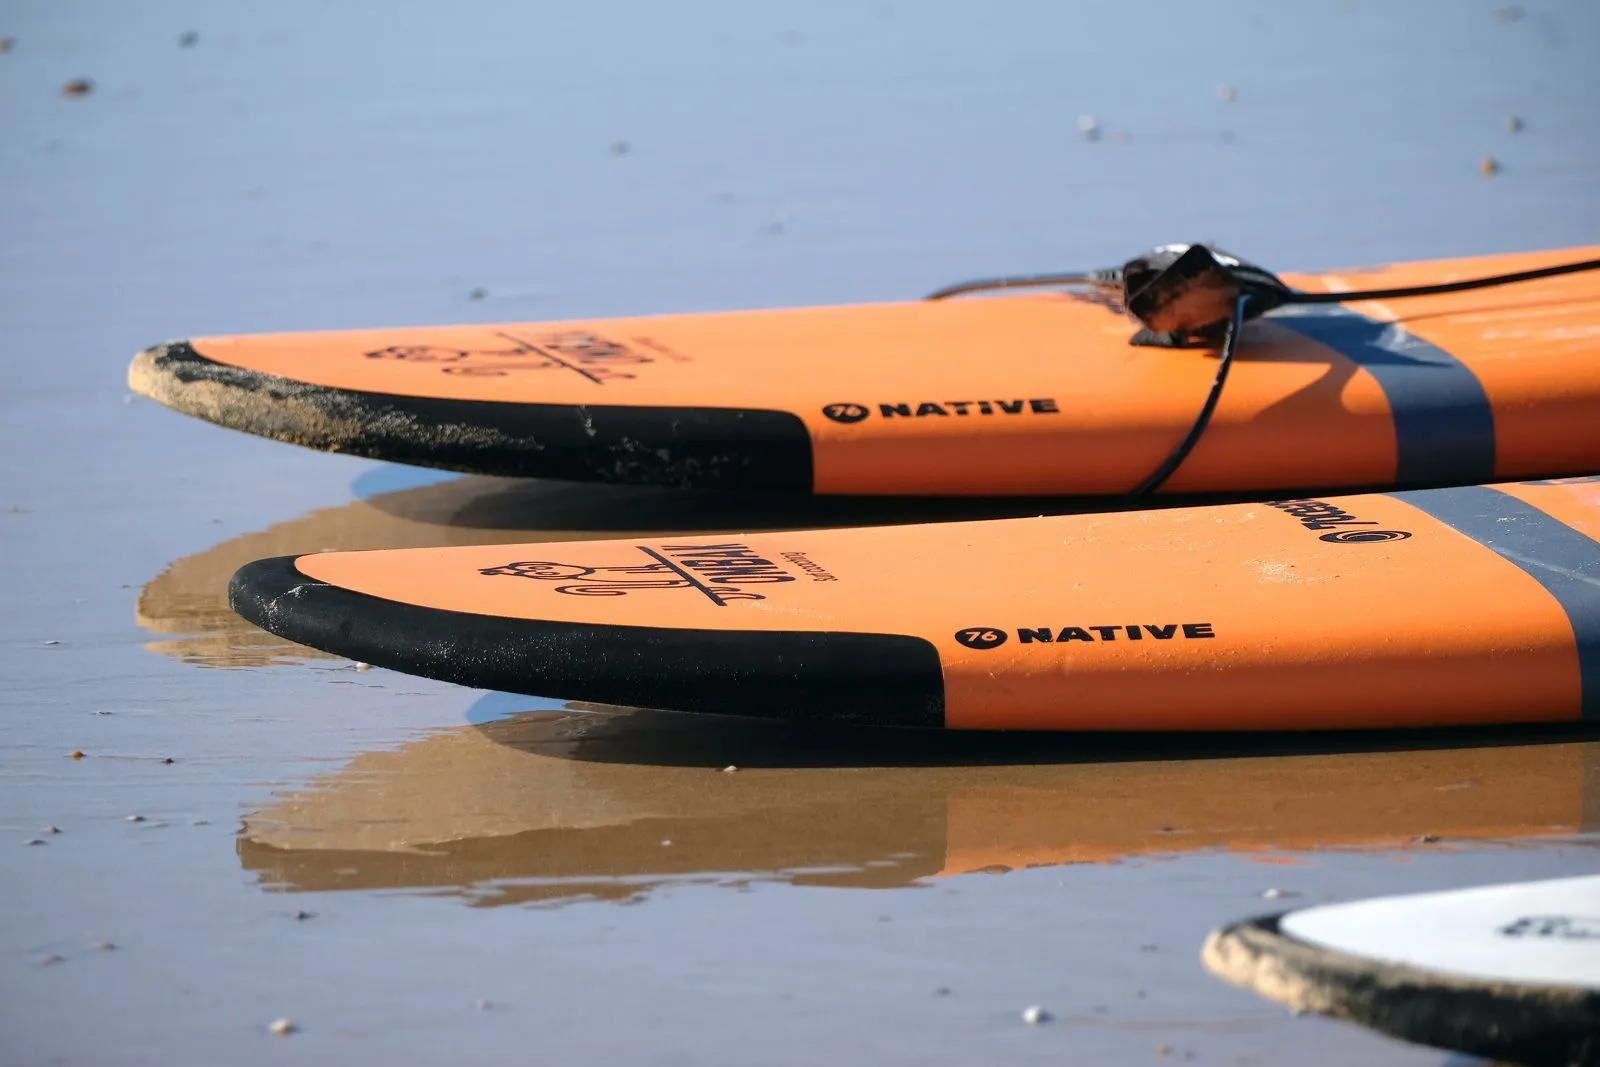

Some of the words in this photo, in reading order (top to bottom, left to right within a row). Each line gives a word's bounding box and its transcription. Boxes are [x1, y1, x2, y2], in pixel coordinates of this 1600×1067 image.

[879, 399, 1059, 418] NATIVE
[660, 543, 796, 583] OMBAK
[1018, 623, 1216, 644] NATIVE
